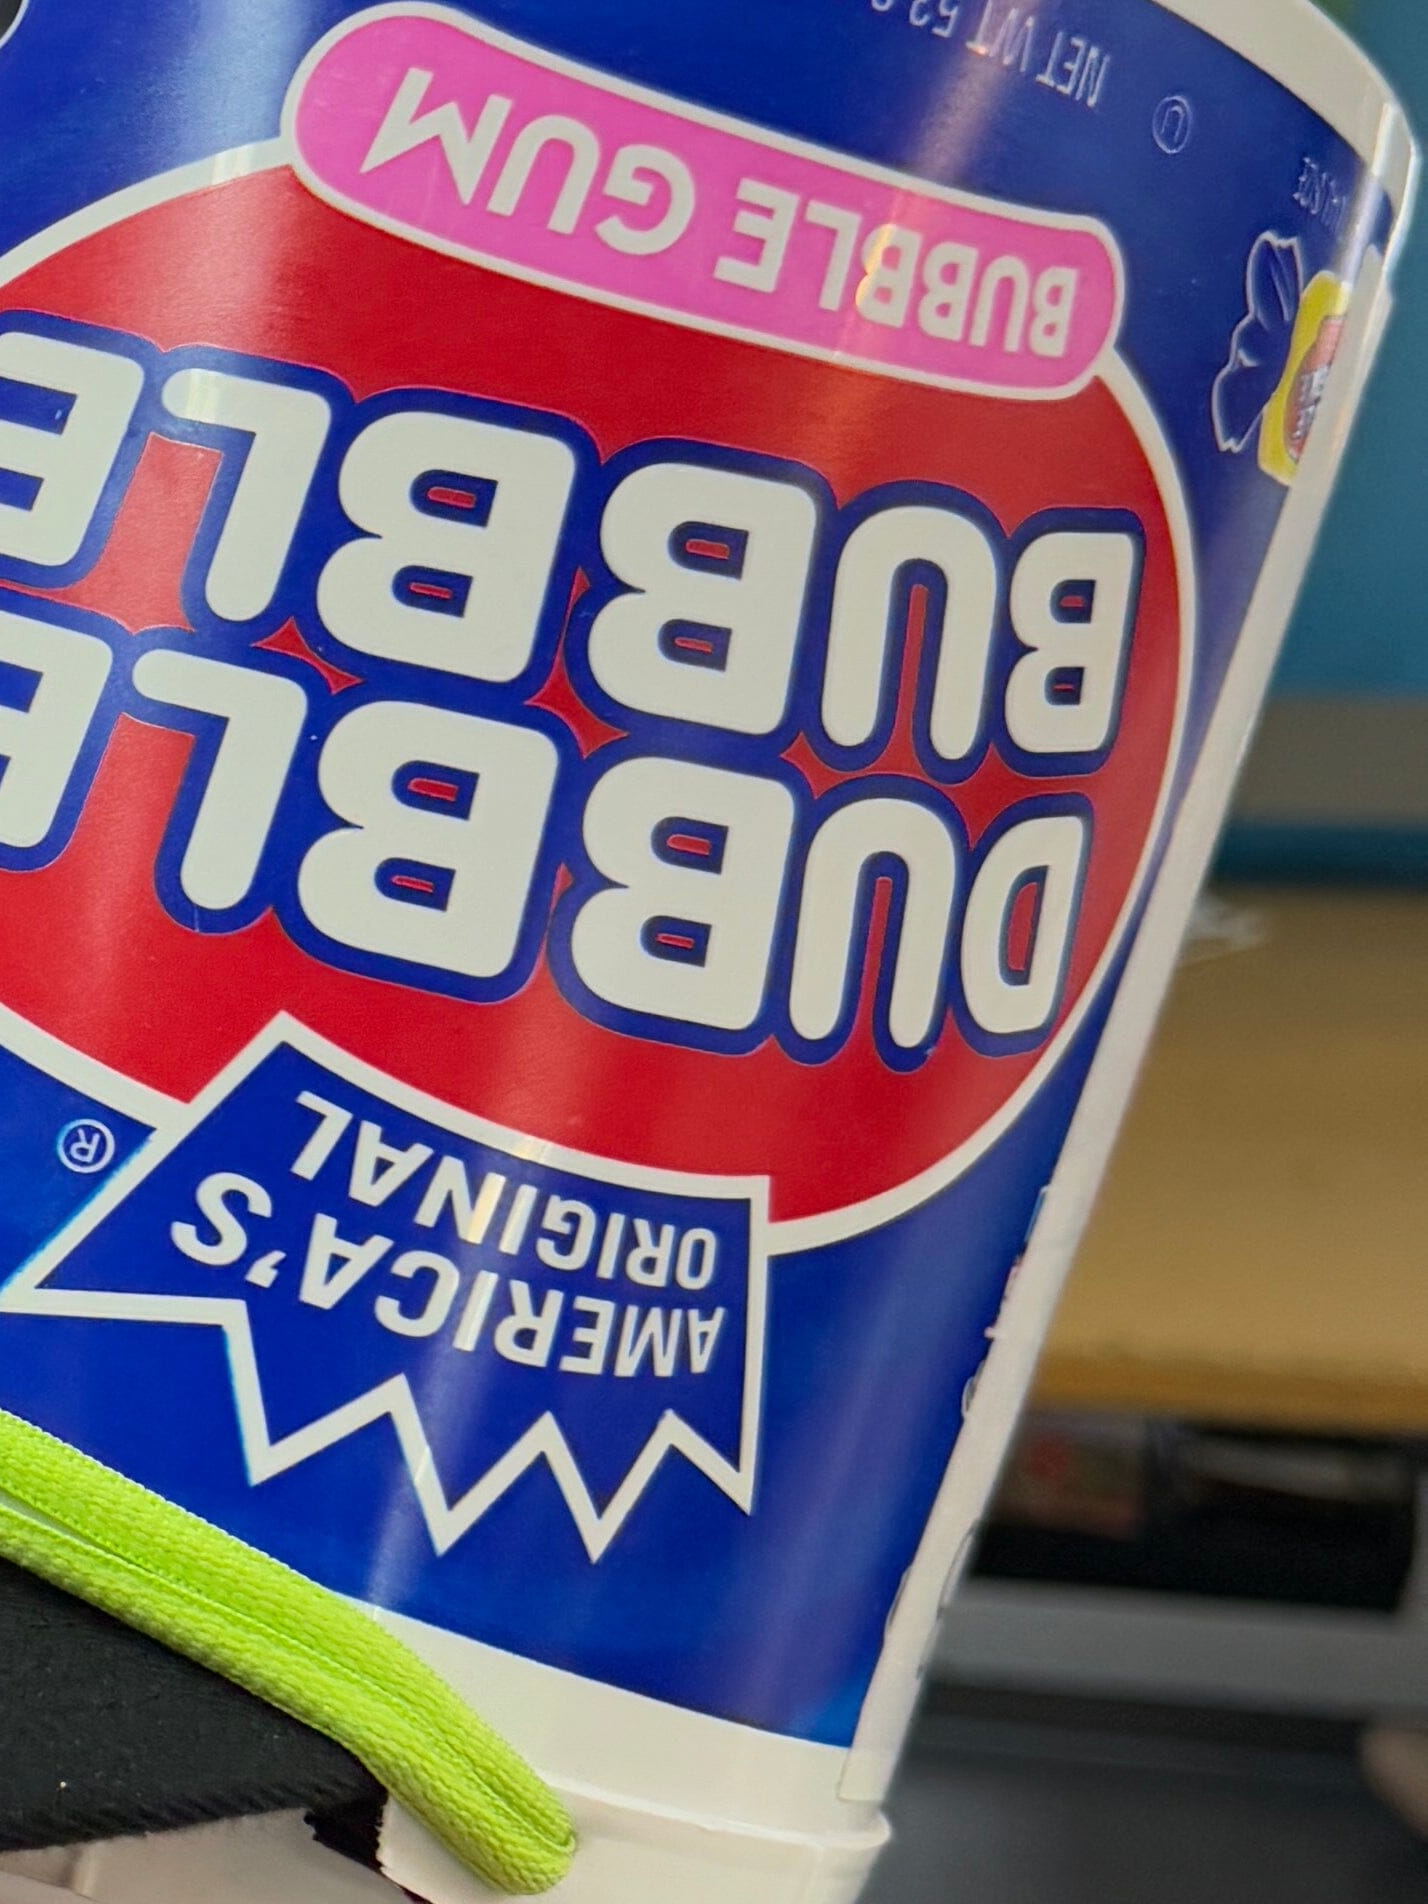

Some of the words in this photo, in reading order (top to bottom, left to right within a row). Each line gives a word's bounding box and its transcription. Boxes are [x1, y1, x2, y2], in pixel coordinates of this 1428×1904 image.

[966, 10, 1036, 74] WT
[1036, 47, 1110, 108] NET
[359, 67, 696, 257] GUM
[714, 177, 1080, 359] BUBBLE
[170, 1171, 726, 1379] AMERICA'S
[290, 1089, 716, 1290] ORIGINAL
